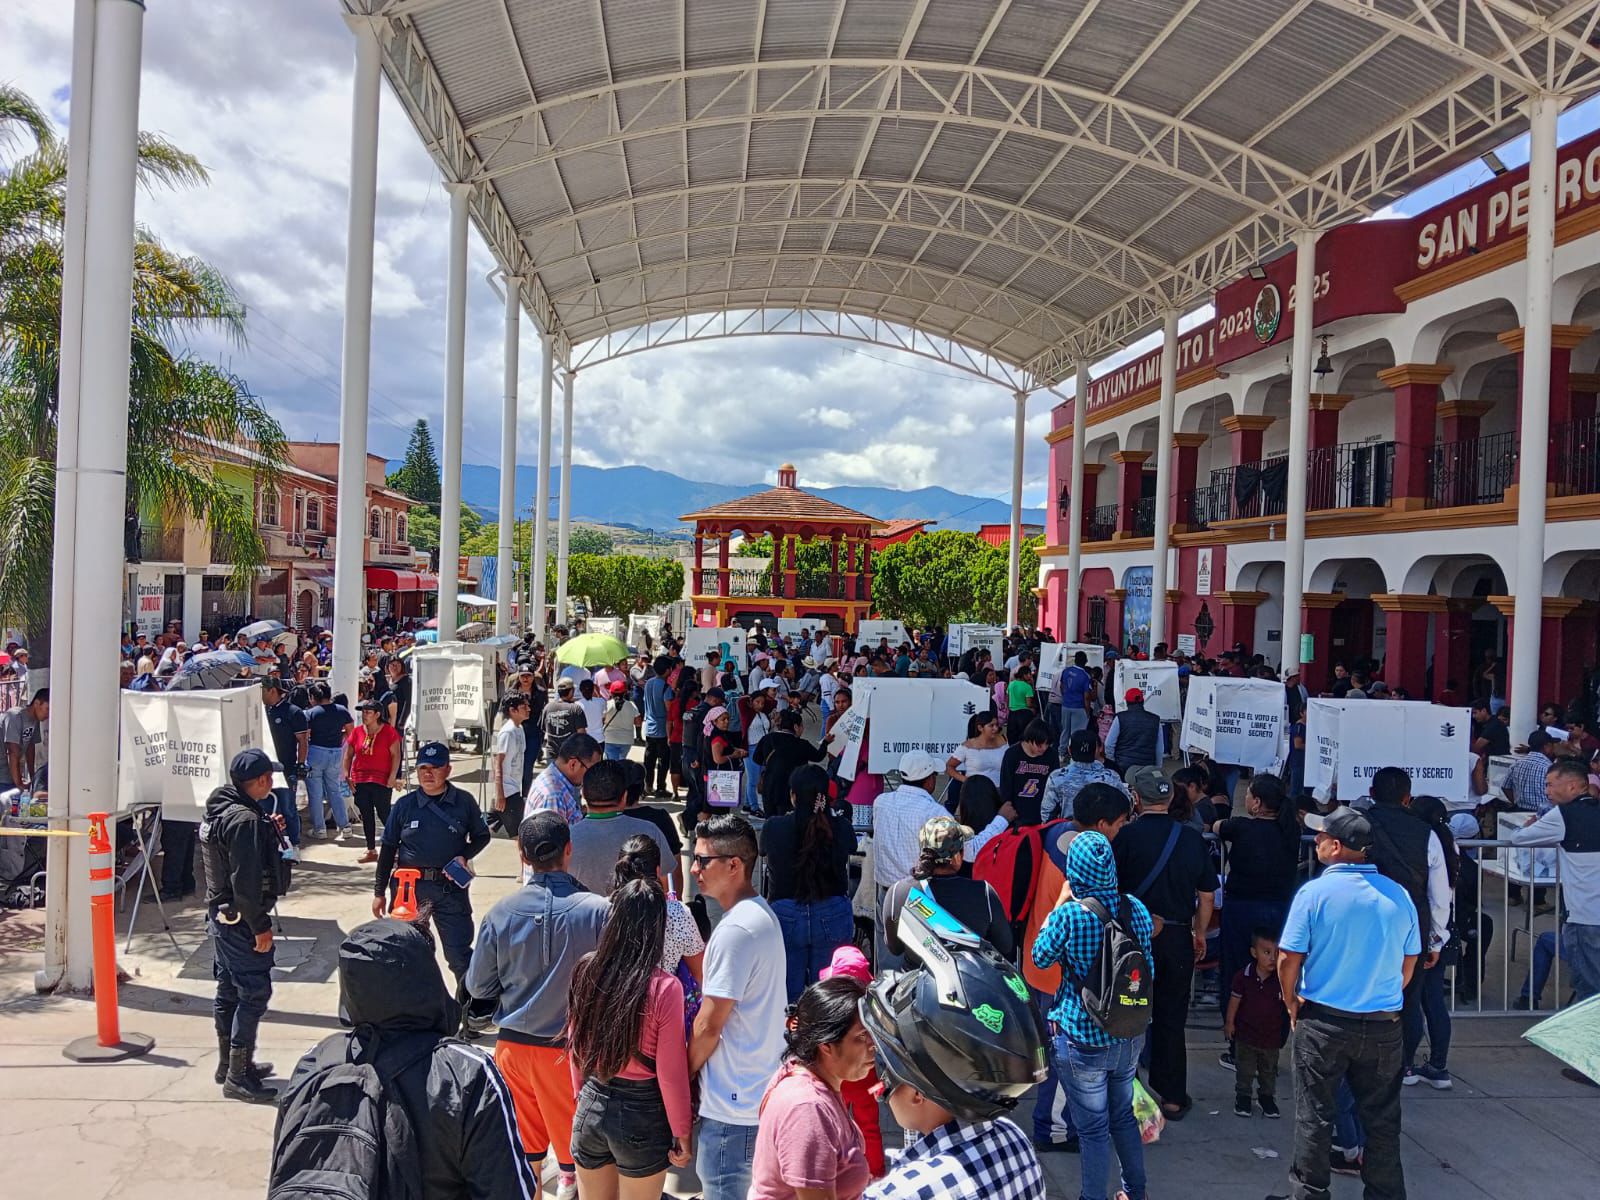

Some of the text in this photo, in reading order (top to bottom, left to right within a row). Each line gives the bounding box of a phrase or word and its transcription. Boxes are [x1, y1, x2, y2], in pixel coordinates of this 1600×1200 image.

[1417, 146, 1600, 266] SAN PERO
[1288, 271, 1331, 312] 225
[1219, 307, 1252, 342] 2023
[1097, 333, 1204, 405] AYUNTAMITO
[428, 687, 444, 696] VOTO
[444, 687, 452, 695] ES
[456, 684, 471, 692] VOTO
[426, 696, 441, 704] LIBRE
[424, 703, 449, 712] SECRETO
[1222, 711, 1238, 719] VOTO
[1238, 711, 1246, 720] ES
[1246, 713, 1278, 723] EL VOTO ES
[1218, 718, 1241, 727] LIBRE Y
[1250, 722, 1267, 730] LIBRE
[1216, 726, 1242, 735] SECRETO
[1248, 729, 1274, 738] SECRETO
[134, 736, 146, 746] EL
[168, 739, 217, 754] EL VOTO ES
[883, 741, 892, 753] EL
[893, 741, 910, 753] VOTO
[911, 741, 920, 751] ES
[921, 742, 939, 754] LIBRE
[940, 742, 946, 753] Y
[175, 753, 209, 765] LIBRE Y
[171, 765, 211, 778] SECRETO
[1353, 766, 1362, 778] EL
[1416, 767, 1423, 779] Y
[1422, 767, 1453, 779] SECRETO
